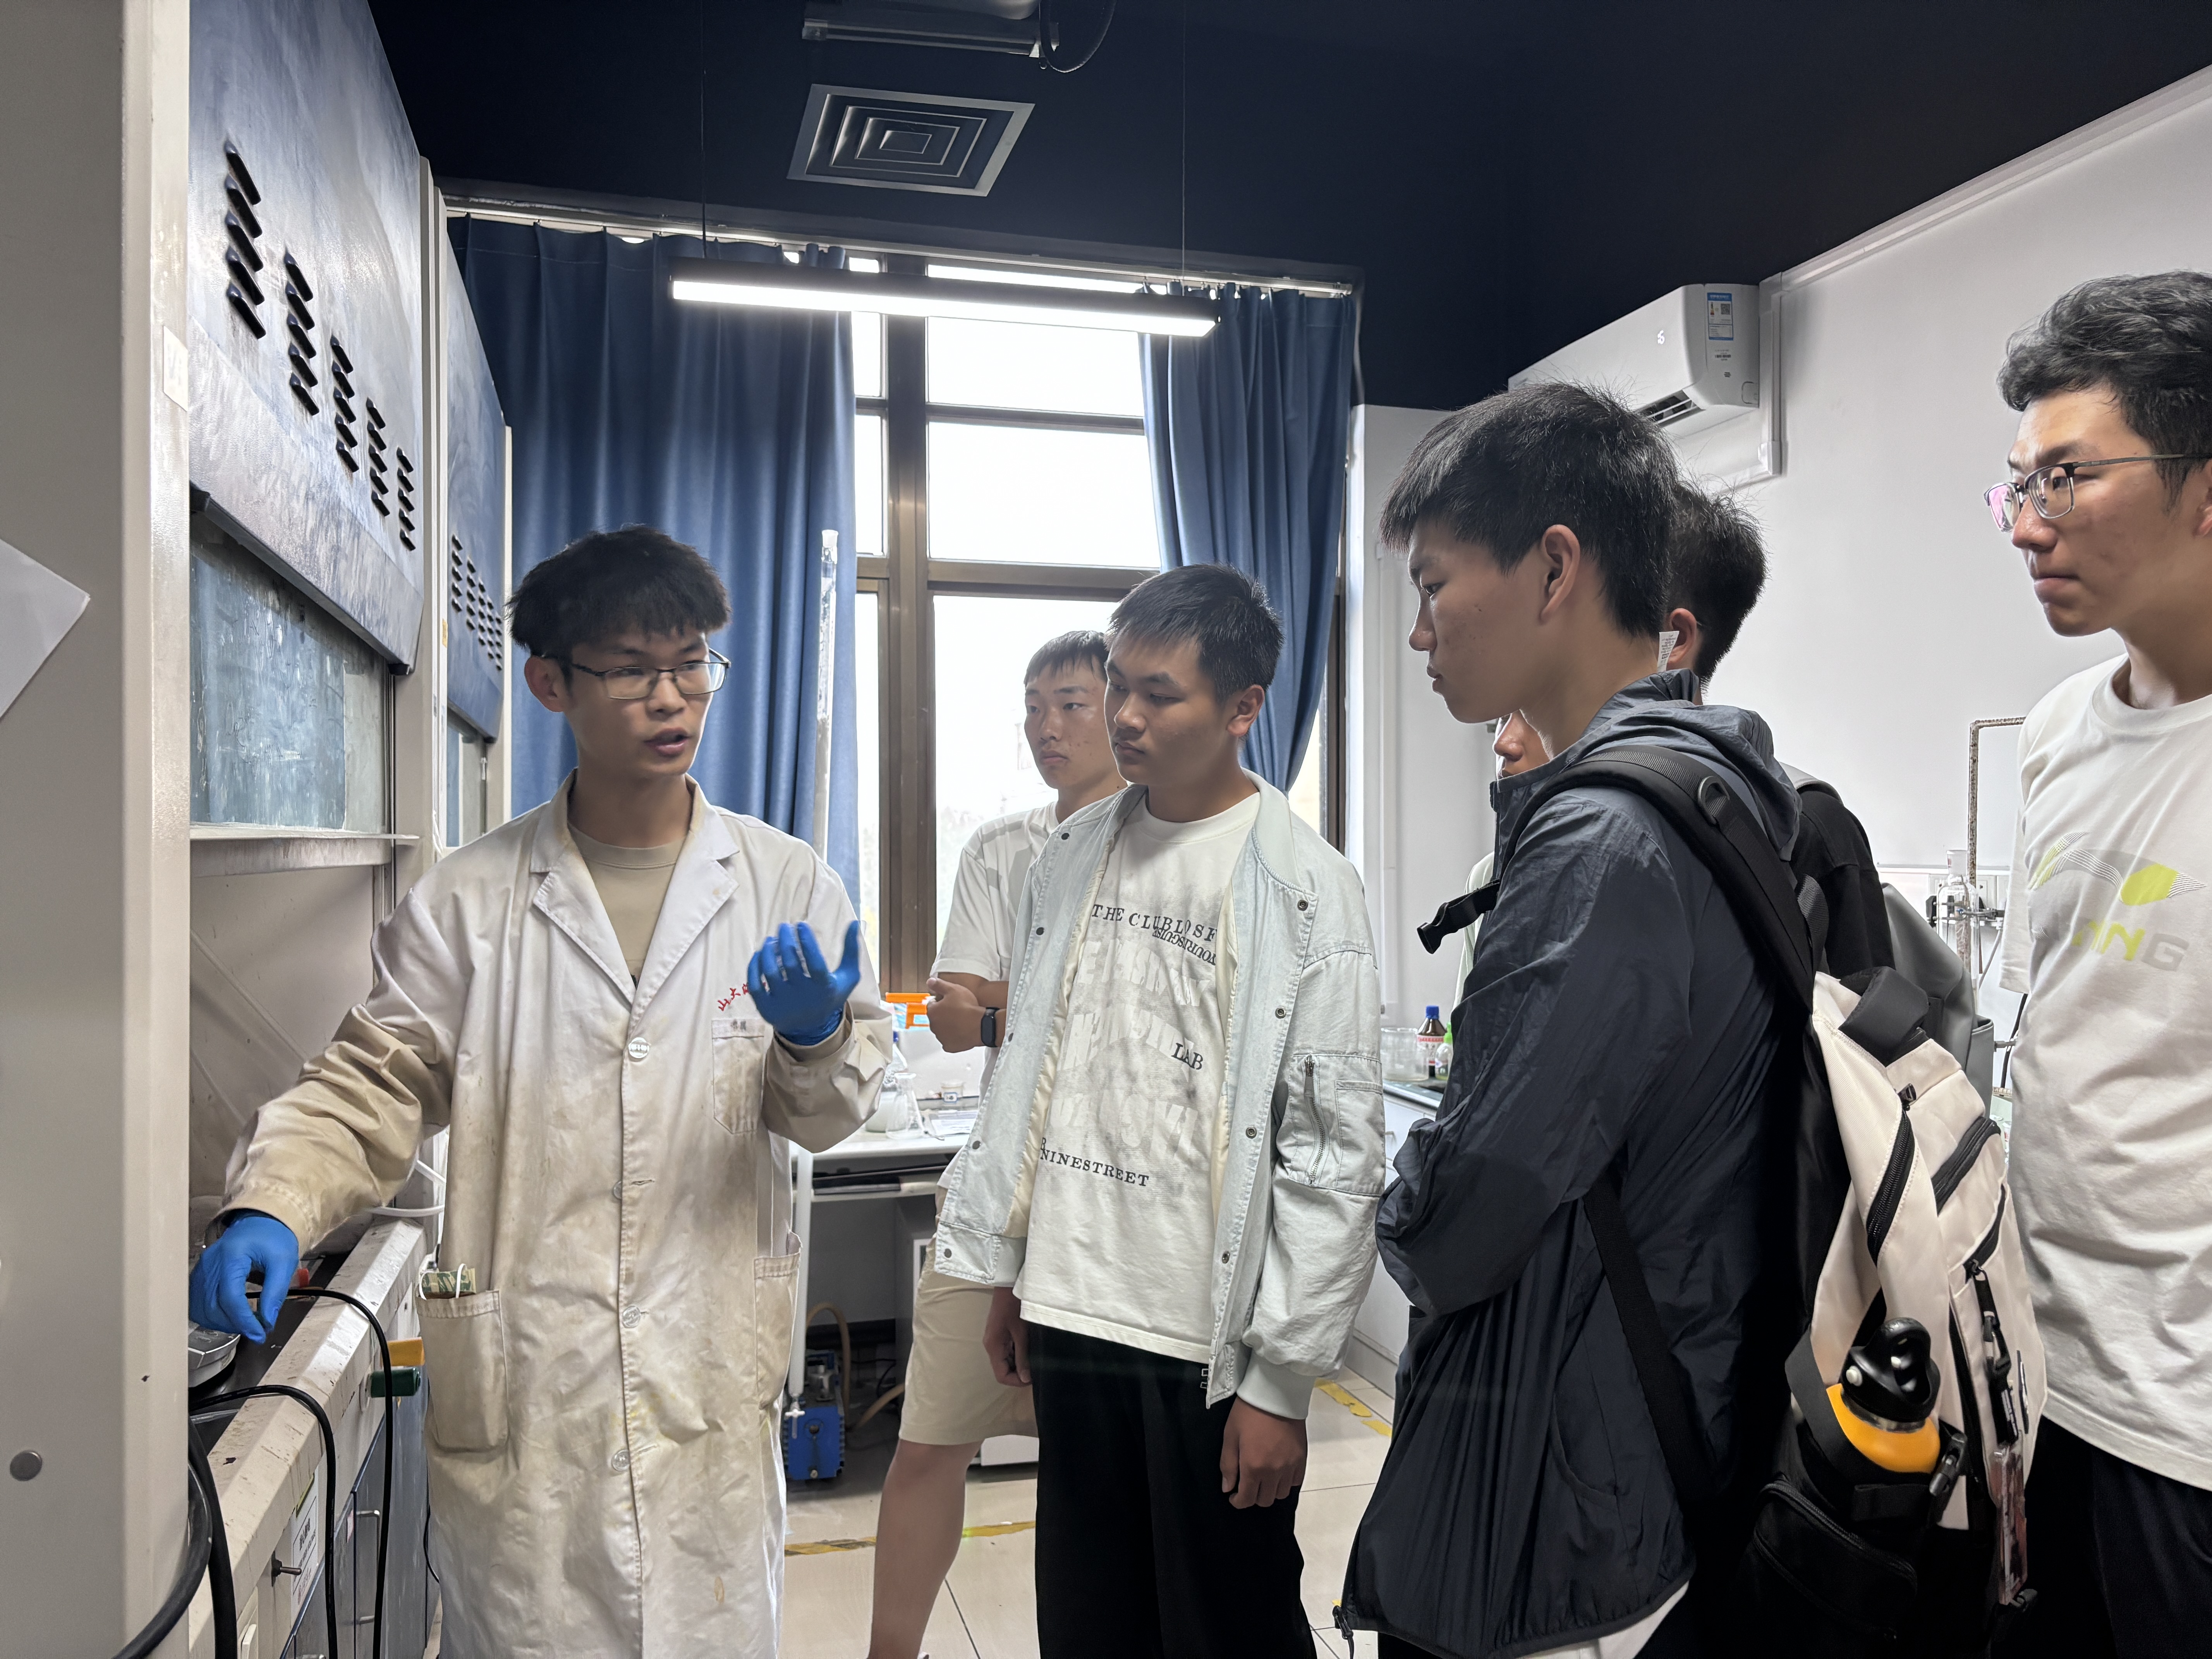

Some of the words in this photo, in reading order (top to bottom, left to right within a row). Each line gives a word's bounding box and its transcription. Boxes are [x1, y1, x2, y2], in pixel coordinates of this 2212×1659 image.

[1091, 903, 1125, 921] THE
[1171, 1042, 1204, 1070] LAB
[1040, 1149, 1149, 1187] NINESTREET
